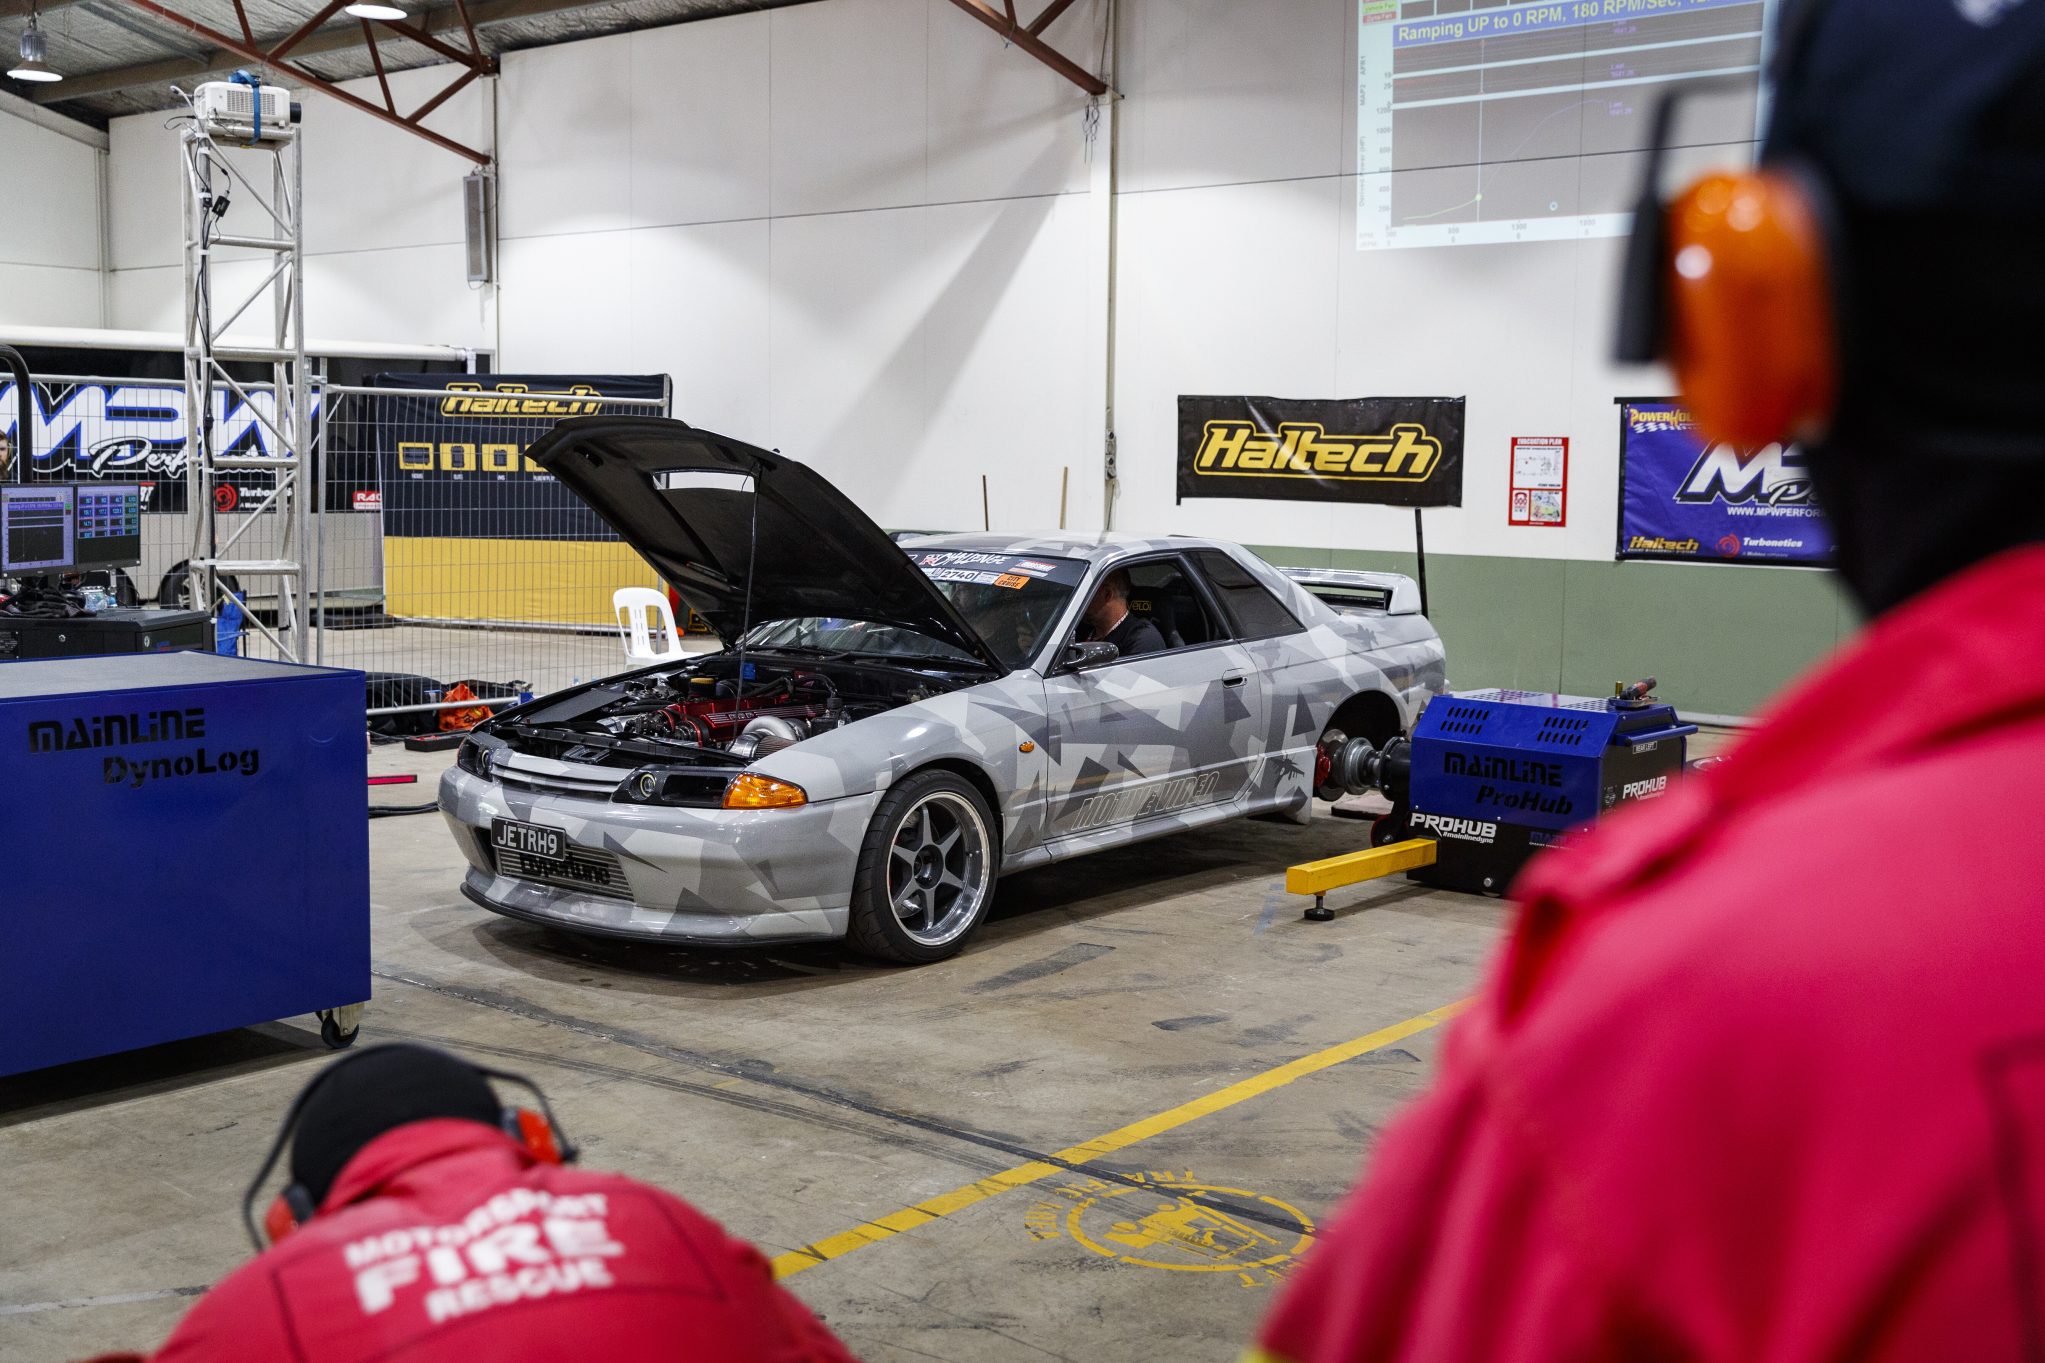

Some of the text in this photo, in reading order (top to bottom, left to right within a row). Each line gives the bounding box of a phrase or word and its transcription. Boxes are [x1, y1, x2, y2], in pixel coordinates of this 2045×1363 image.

[1399, 22, 1464, 41] Ramping
[1468, 16, 1489, 32] UP
[1493, 15, 1508, 29] to
[1513, 12, 1522, 26] 0
[1526, 6, 1567, 24] RPM,
[1572, 3, 1599, 18] 180
[1200, 427, 1434, 474] Haltech
[1629, 536, 1699, 551] Haltech
[1743, 537, 1803, 548] Turbonetics
[941, 570, 975, 580] 2740
[103, 747, 260, 789] DynoLog
[1476, 784, 1573, 815] ProHub
[1622, 775, 1667, 801] PROHUB
[497, 824, 557, 855] JETRH9
[1410, 812, 1497, 838] PROHUB
[1442, 831, 1494, 844] #mainlinedyno
[355, 1215, 626, 1316] FIRE
[423, 1257, 615, 1325] RESCUE
